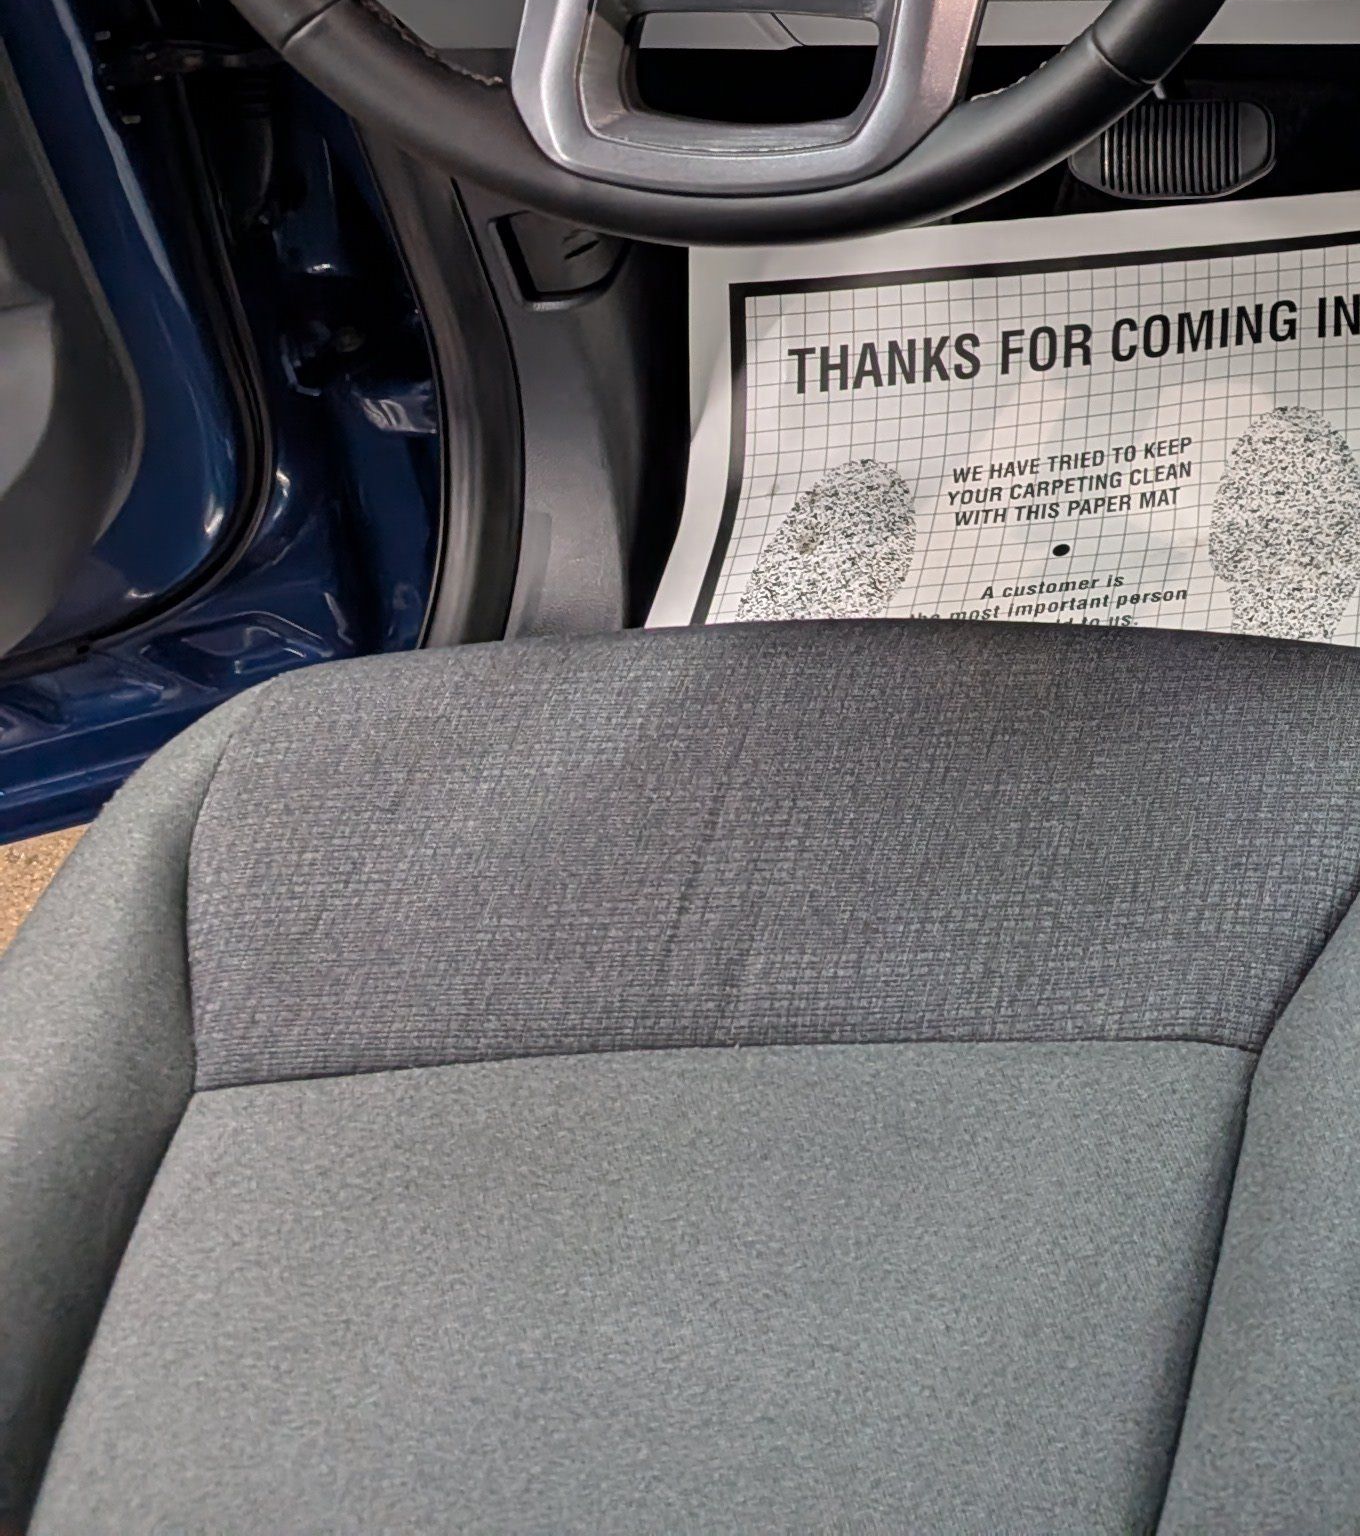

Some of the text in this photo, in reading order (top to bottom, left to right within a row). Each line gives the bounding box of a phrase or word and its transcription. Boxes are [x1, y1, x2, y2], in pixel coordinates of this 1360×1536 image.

[787, 293, 1360, 394] THANKS FOR COMING IN
[953, 437, 1192, 484] WE HAVE TRIED TO KEEP
[948, 461, 1193, 506] YOUR CARPETING CLEAN
[955, 487, 1180, 526] WITH THIS PAPER MAT
[950, 590, 1188, 620] most important person
[980, 574, 1125, 600] A customer is
